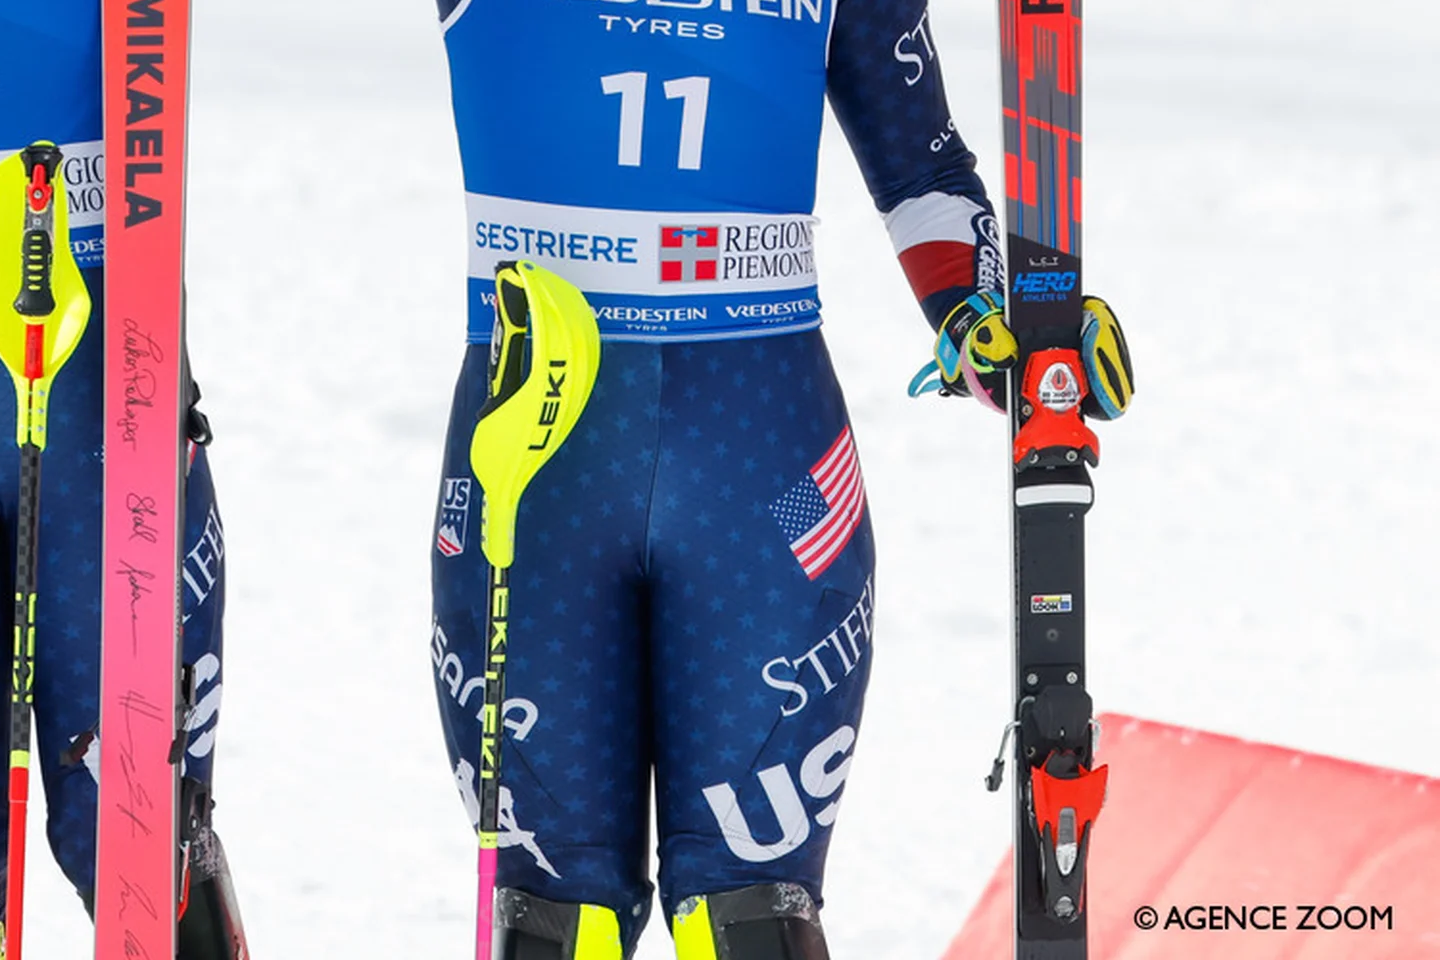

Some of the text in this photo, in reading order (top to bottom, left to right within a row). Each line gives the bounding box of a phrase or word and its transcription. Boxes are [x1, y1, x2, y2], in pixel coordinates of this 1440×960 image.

[597, 13, 726, 40] TYRES
[600, 71, 711, 171] 11
[474, 221, 639, 264] SESTRIERE
[1012, 270, 1078, 294] HERO
[528, 359, 568, 451] LEKI
